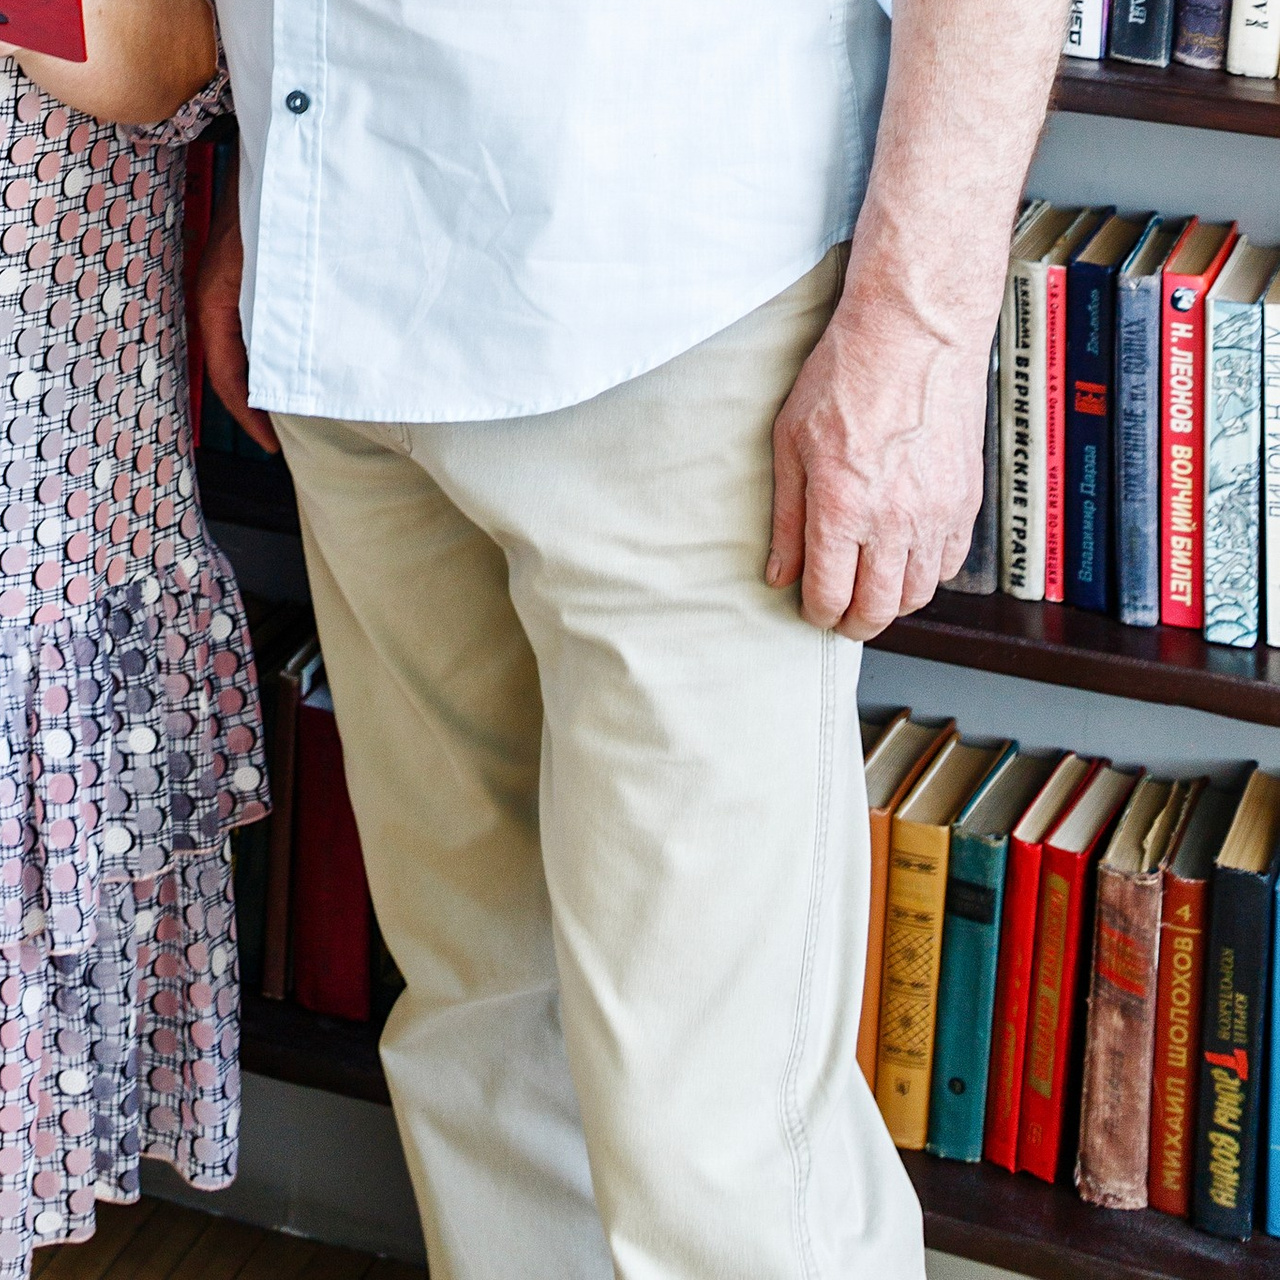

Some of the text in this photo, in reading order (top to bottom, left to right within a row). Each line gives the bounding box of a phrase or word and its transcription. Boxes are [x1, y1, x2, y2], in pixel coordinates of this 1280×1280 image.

[1169, 346, 1192, 434] ЛЕОНОВ
[1009, 356, 1031, 588] ВЕРНЕЙСКИЕ ГРАЧИ
[1169, 445, 1199, 533] ВОЛЧИЙ
[1169, 537, 1192, 607] БИЛЕТ
[1161, 934, 1194, 1191] МИХАИЛ ШОЛОХОВ
